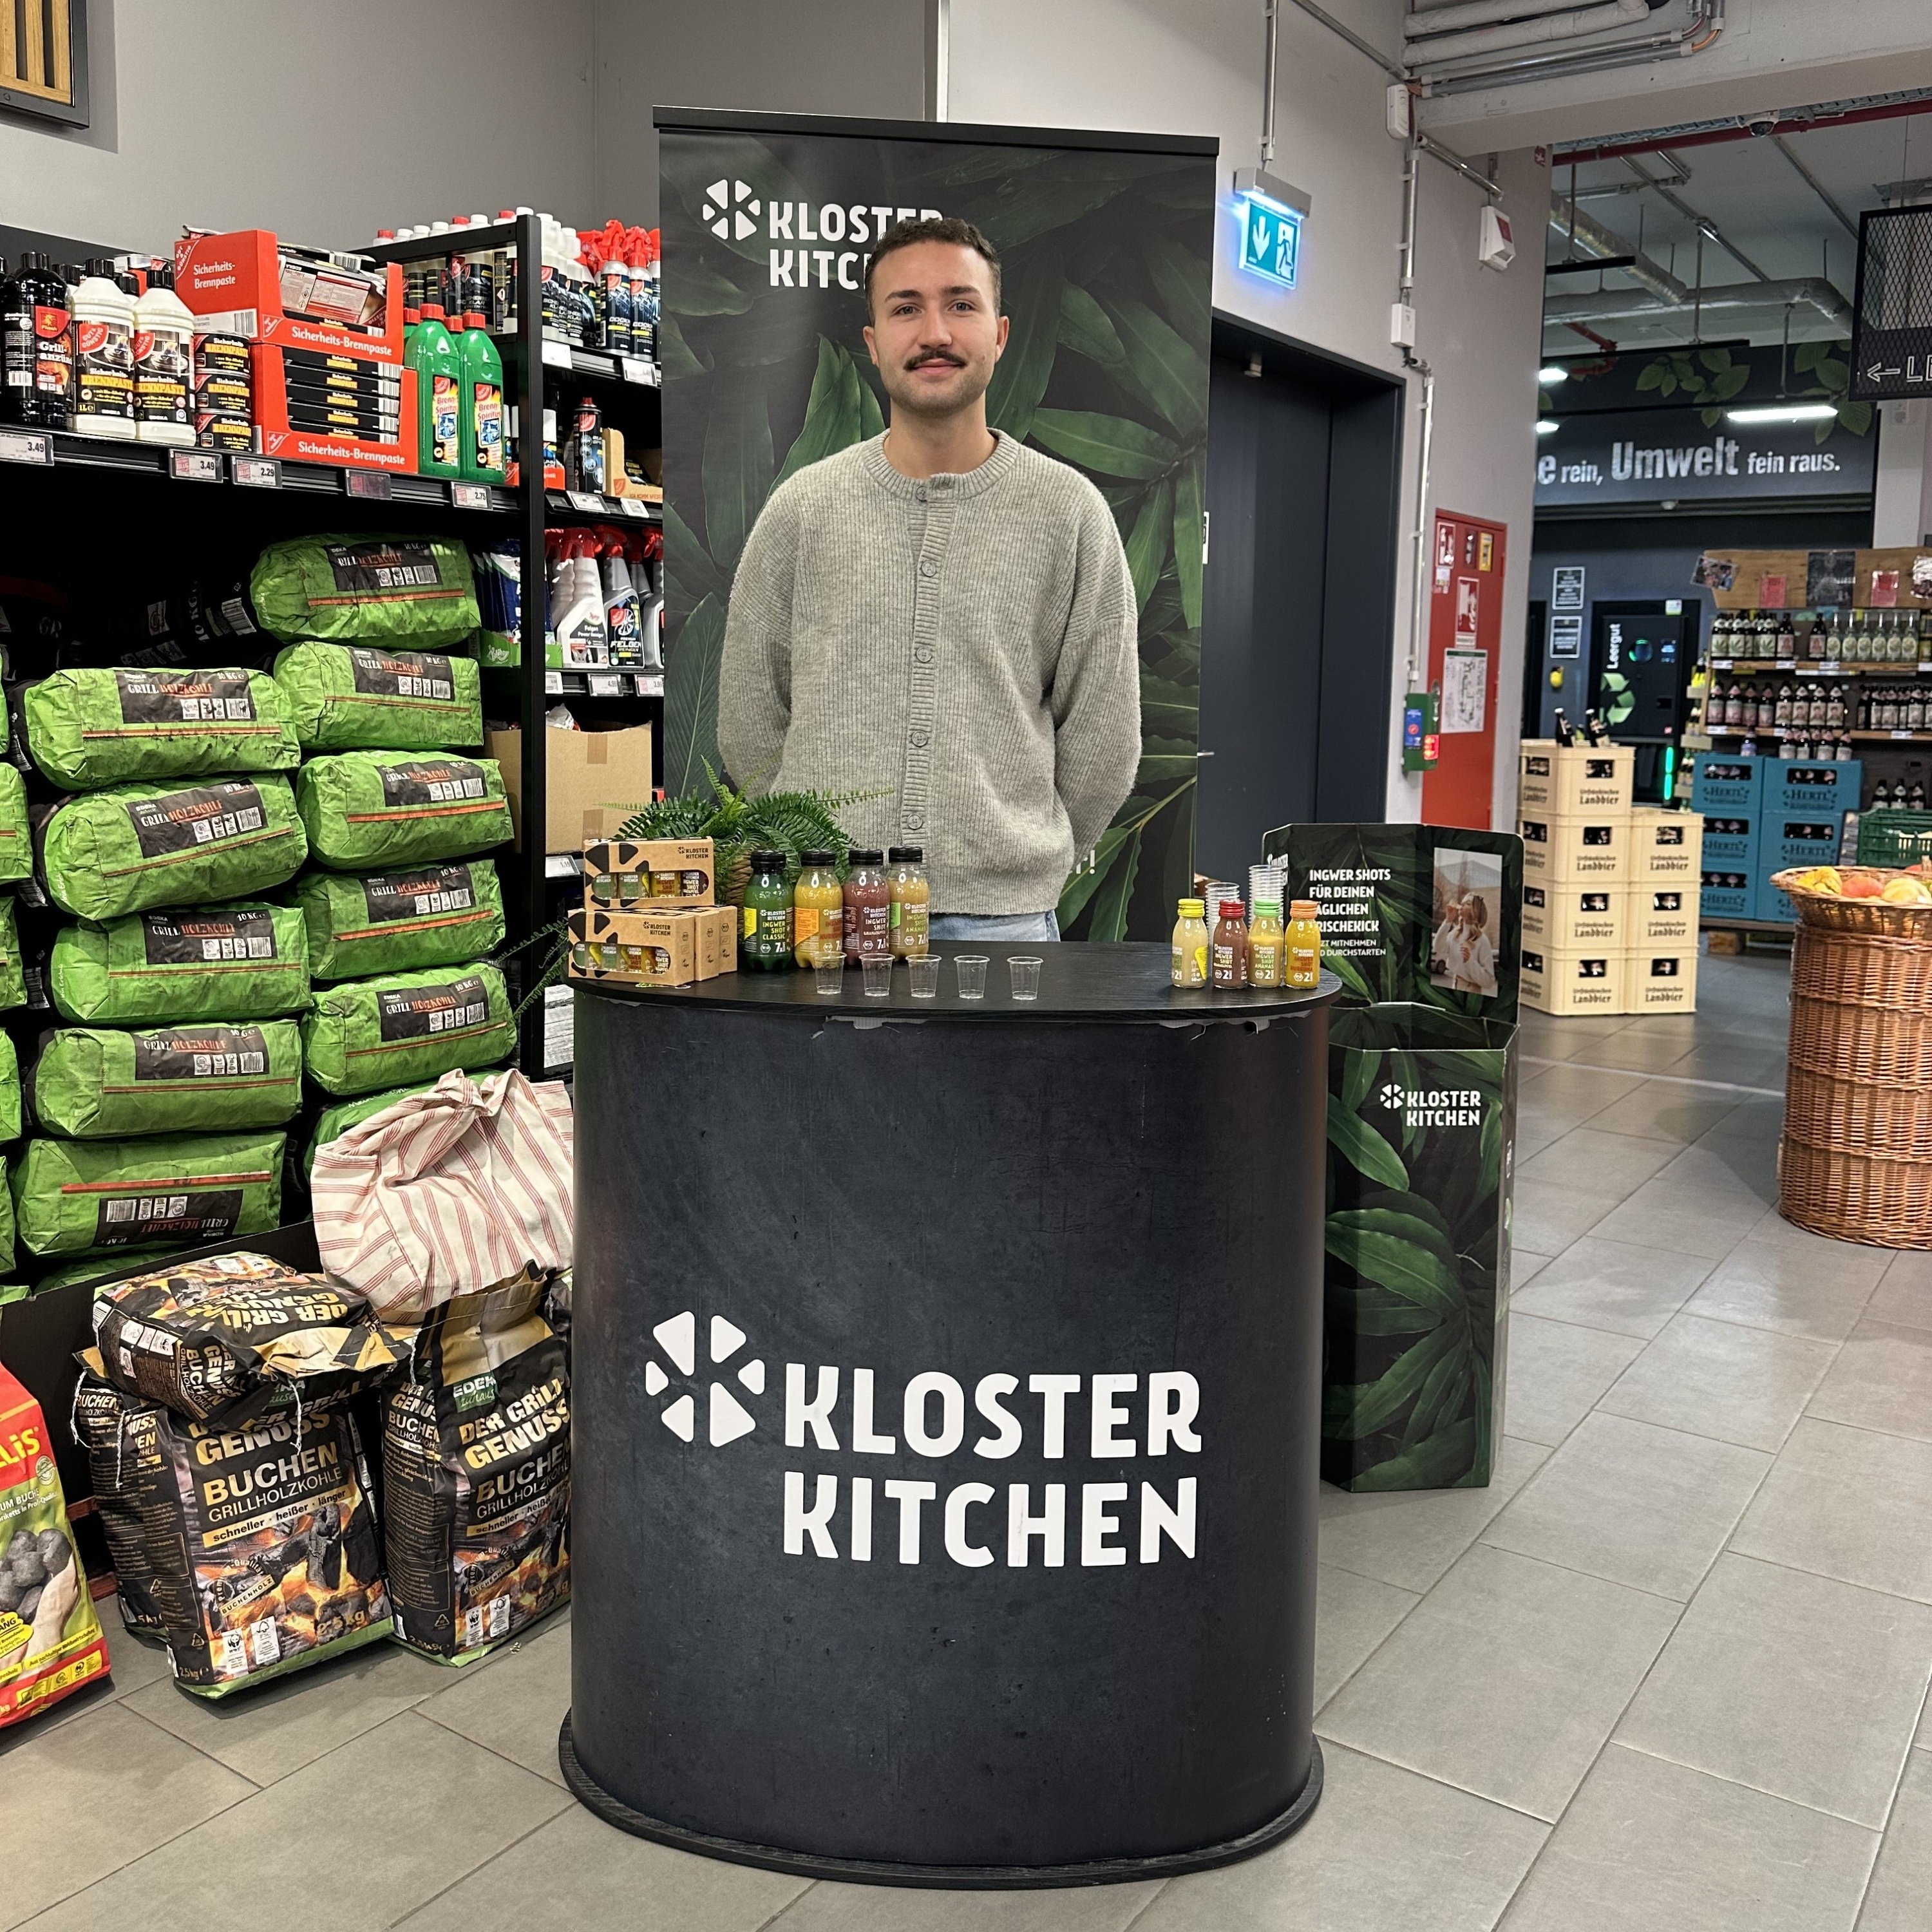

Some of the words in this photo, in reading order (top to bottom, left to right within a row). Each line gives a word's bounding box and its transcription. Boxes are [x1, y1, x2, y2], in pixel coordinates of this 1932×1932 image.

[193, 260, 236, 276] Sicherheits-
[770, 249, 870, 290] KITC
[194, 275, 236, 290] Brennpaste
[40, 341, 67, 353] Grill-
[292, 326, 392, 356] Sicherheits-Brennpaste
[478, 403, 498, 412] Brenn-
[478, 412, 501, 421] Spiritus
[27, 441, 44, 453] 3.49
[298, 440, 405, 465] Sicherheits-Brennpaste
[200, 460, 214, 471] 3.49
[1560, 460, 1604, 486] rein,
[1611, 437, 1739, 481] Umwelt
[1747, 451, 1785, 475] fein
[1789, 452, 1841, 473] raus.
[261, 468, 275, 477] 2.29
[475, 491, 486, 500] 2.75
[337, 556, 357, 567] RILL
[611, 640, 642, 649] FELGEN
[128, 684, 159, 694] GRILL
[1309, 869, 1354, 882] INGWER
[1356, 868, 1391, 881] SHOTS
[371, 885, 397, 896] GRILL
[1309, 884, 1332, 898] FÜR
[1334, 886, 1374, 898] DEINEN
[1316, 902, 1368, 915] ÄGLICHEN
[152, 925, 180, 936] GRILL
[1318, 920, 1379, 933] RISCHEKICK
[1326, 948, 1386, 956] DURCHSTARTEN
[386, 1002, 411, 1014] GRILL
[143, 1040, 172, 1051] GRILL
[1406, 1090, 1481, 1108] KLOSTER
[1406, 1110, 1481, 1127] KITCHEN
[294, 1304, 348, 1321] DER
[785, 1362, 1202, 1459] KLOSTER
[459, 1412, 506, 1444] DER
[202, 1441, 339, 1506] BUCHEN
[208, 1466, 343, 1522] GRILLHOLZKOHLE
[213, 1519, 265, 1542] schneller
[276, 1502, 308, 1520] heißer
[317, 1488, 346, 1506] länger
[783, 1470, 1197, 1567] KITCHEN
[476, 1513, 519, 1534] schneller
[222, 1578, 273, 1615] BUCHENHOLZ
[345, 1610, 365, 1627] kg
